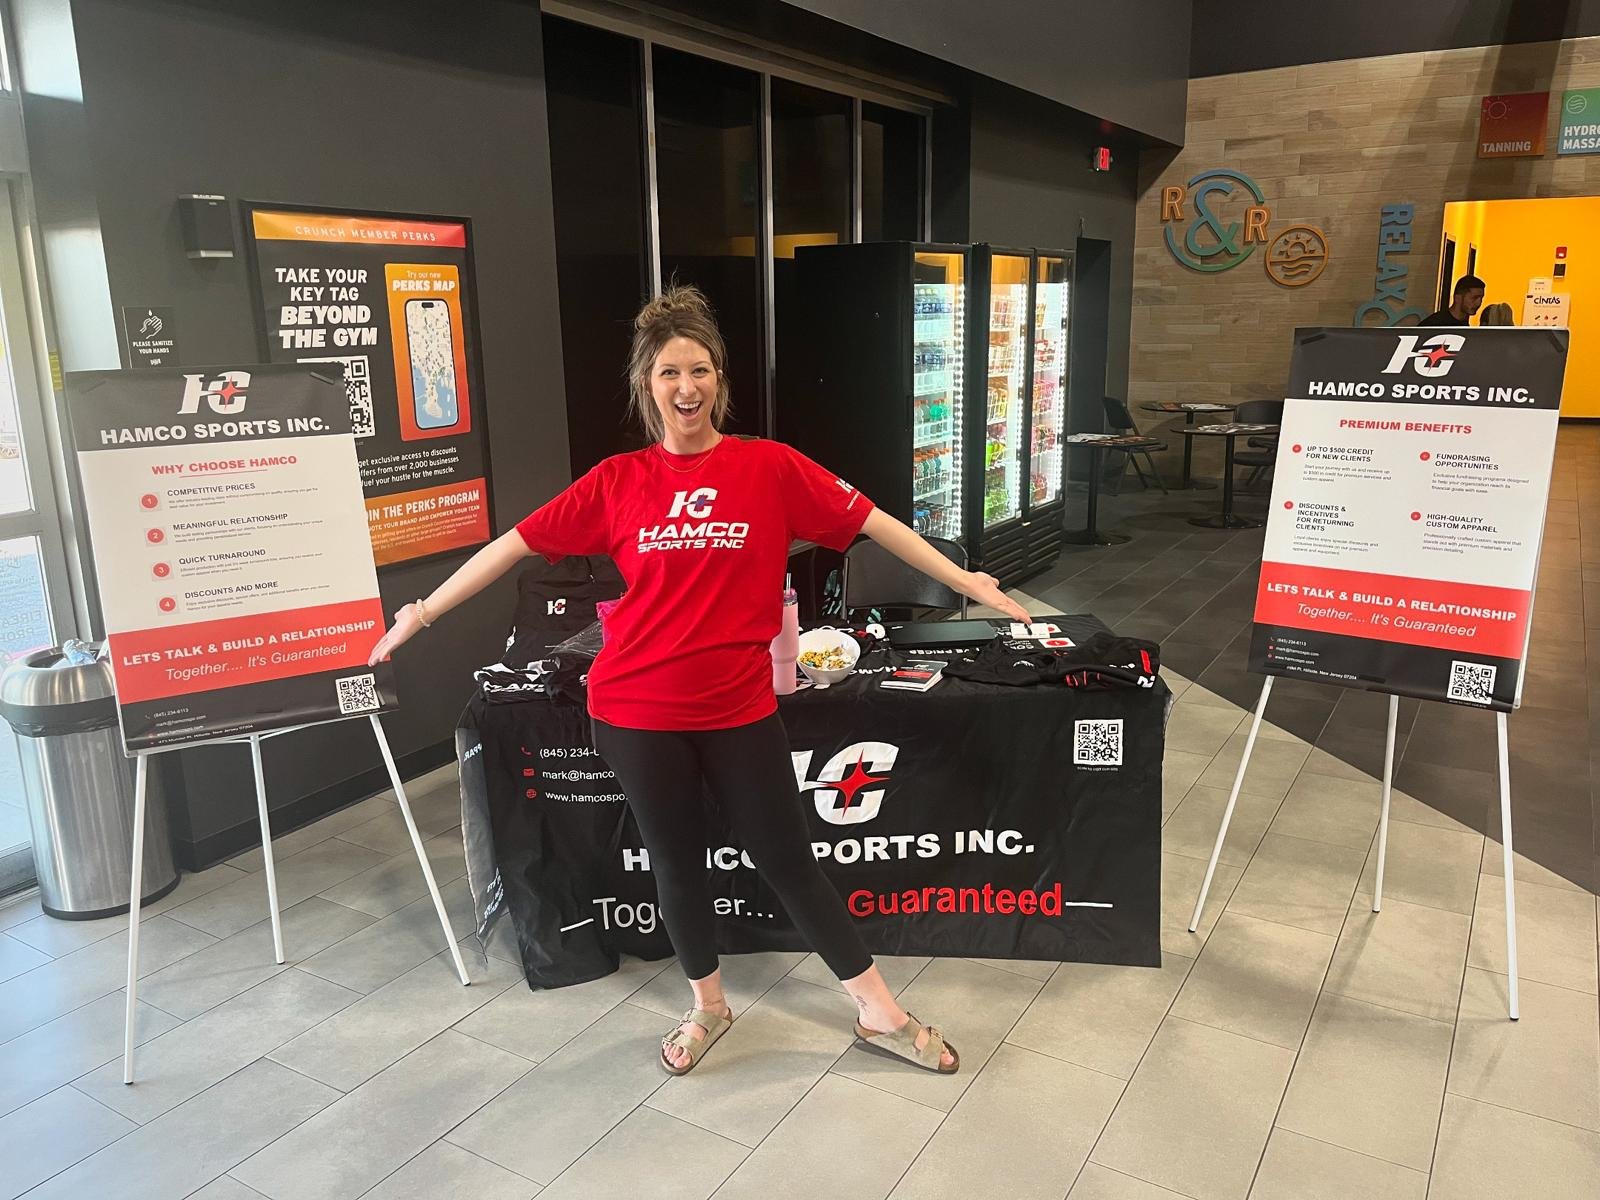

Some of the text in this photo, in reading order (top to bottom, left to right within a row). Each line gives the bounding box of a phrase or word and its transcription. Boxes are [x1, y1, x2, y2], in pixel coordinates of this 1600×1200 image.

[1482, 141, 1531, 153] TANNING
[1161, 184, 1185, 220] R
[1243, 206, 1270, 246] R
[295, 225, 436, 242] CRUNCH MEMBER PERKS
[1375, 203, 1415, 302] RELAX
[275, 268, 368, 283] TAKE YOUR
[406, 270, 417, 280] Try
[290, 287, 359, 302] KEY TAG
[392, 280, 455, 292] PERKS MAP
[280, 305, 371, 326] BEYOND
[279, 328, 378, 348] THE GYM
[1309, 382, 1535, 403] HAMCO SPORTS INC.
[101, 417, 330, 445] HAMCO SPORTS INC.
[1339, 419, 1472, 434] PREMIUM BENEFITS
[371, 455, 400, 464] exclusive
[401, 452, 422, 460] access
[431, 446, 457, 456] discounts
[1436, 453, 1491, 462] FUNDRAISING
[152, 455, 297, 475] WHY CHOOSE HAMCO
[360, 456, 459, 477] ffers from over 2,000 businesses
[1435, 461, 1499, 470] OPPORTUNITIES
[375, 478, 390, 487] your
[392, 474, 411, 483] hustle
[412, 470, 422, 479] for
[423, 469, 432, 477] the
[167, 485, 224, 496] COMPETITIVE
[225, 483, 256, 492] PRICES
[383, 504, 403, 518] THE
[406, 498, 436, 515] PERKS
[438, 490, 480, 507] PROGRAM
[1299, 503, 1339, 511] DISCOUNTS
[173, 519, 228, 531] MEANINGFUL
[230, 513, 288, 525] RELATIONSHIP
[400, 517, 417, 526] BRAND
[1298, 510, 1339, 518] INCENTIVES
[1312, 518, 1354, 527] RETURNING
[1427, 514, 1483, 523] HIGH-QUALITY
[638, 522, 750, 543] HAMCO
[1296, 523, 1325, 531] CLIENTS
[1426, 521, 1498, 533] CUSTOM APPAREL
[638, 538, 745, 554] SPORTS INC
[179, 556, 206, 565] QUICK
[208, 549, 266, 561] TURNAROUND
[185, 587, 234, 599] DISCOUNTS
[235, 585, 252, 593] AND
[255, 581, 278, 590] MORE
[1267, 582, 1517, 622] LETS TALK & BUILD A RELATIONSHIP
[1371, 613, 1389, 625] It's
[1394, 616, 1476, 637] Guaranteed
[124, 620, 375, 666] LETS TALK & BUILD A RELATIONSHIP
[248, 656, 267, 668] It's
[271, 642, 346, 666] Guaranteed
[539, 748, 567, 759] (845)
[542, 770, 616, 782] mark@hamco
[810, 833, 941, 864] PORTS
[955, 829, 1035, 855] INC.
[848, 883, 1062, 917] Guaranteed
